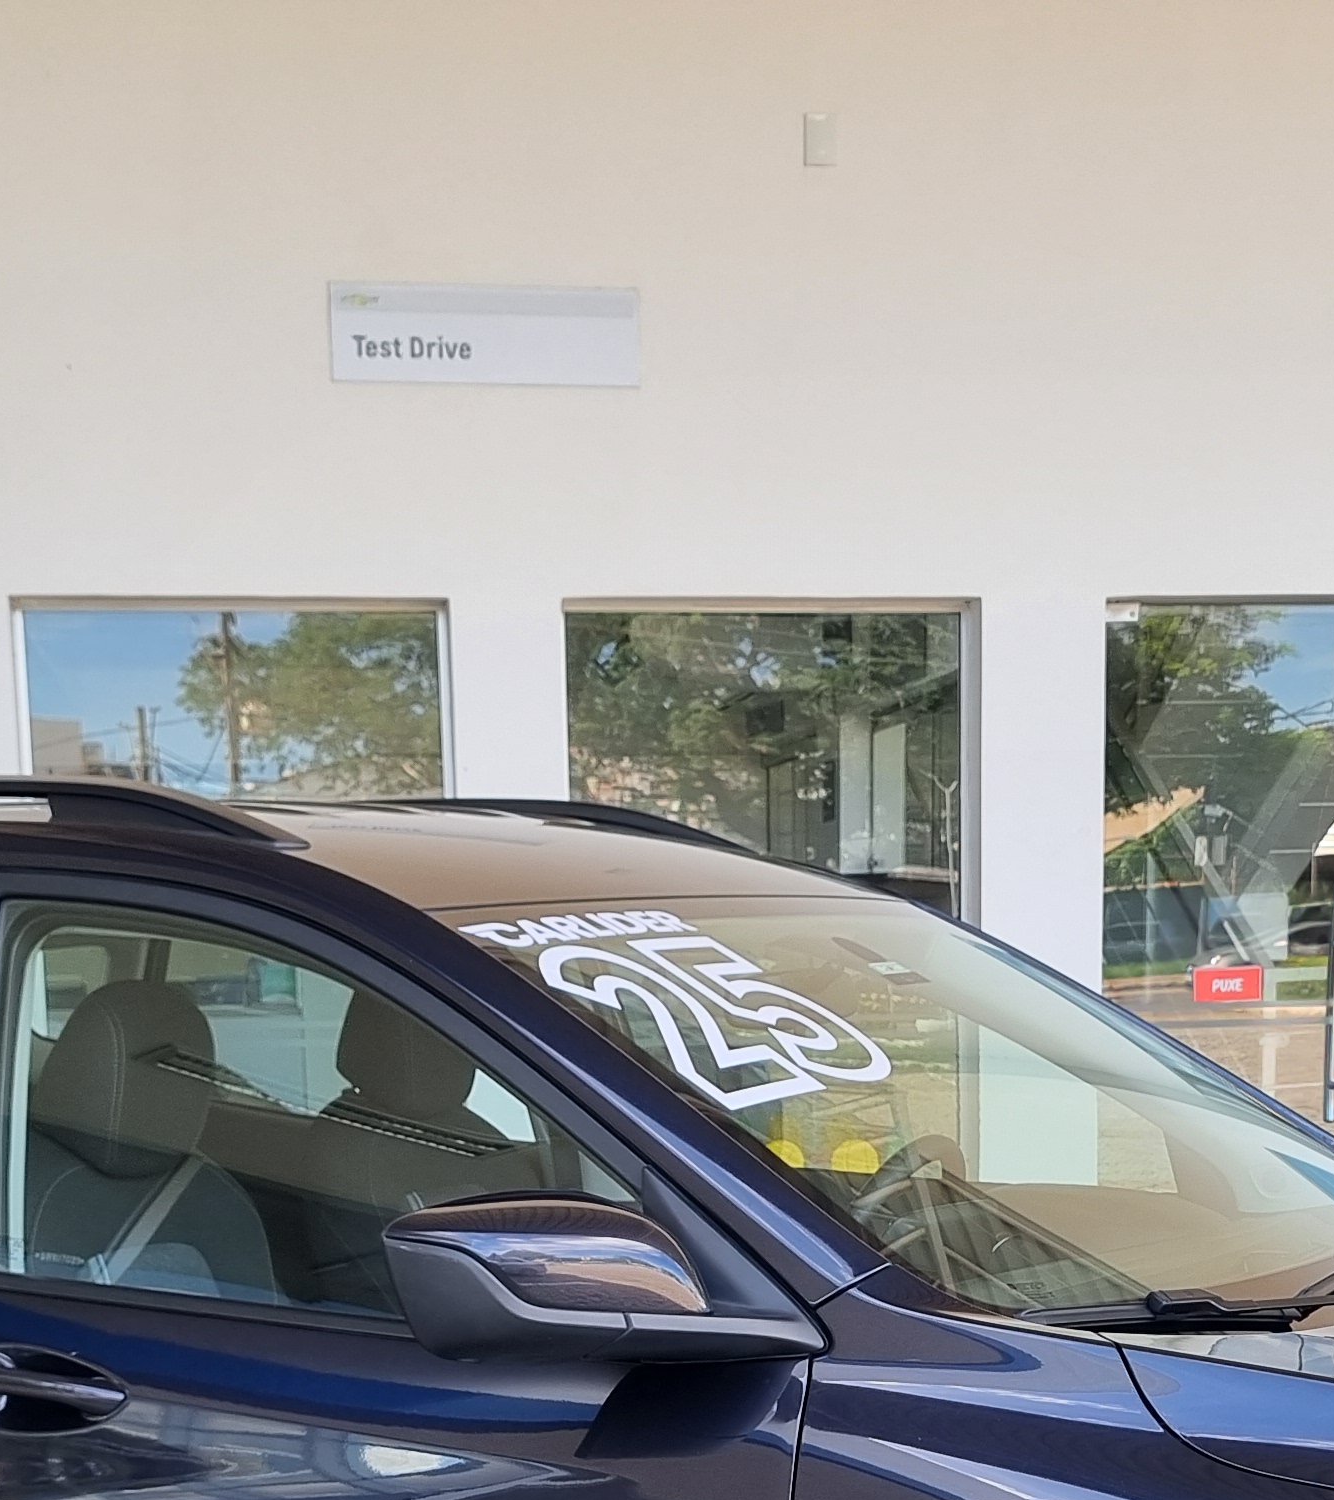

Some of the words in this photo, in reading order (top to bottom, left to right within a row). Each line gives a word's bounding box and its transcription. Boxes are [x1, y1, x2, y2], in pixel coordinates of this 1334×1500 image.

[353, 335, 402, 358] Test
[410, 336, 472, 360] Drive
[458, 910, 698, 948] CARLIDER
[1212, 977, 1244, 993] PUXE
[538, 935, 892, 1111] 25
